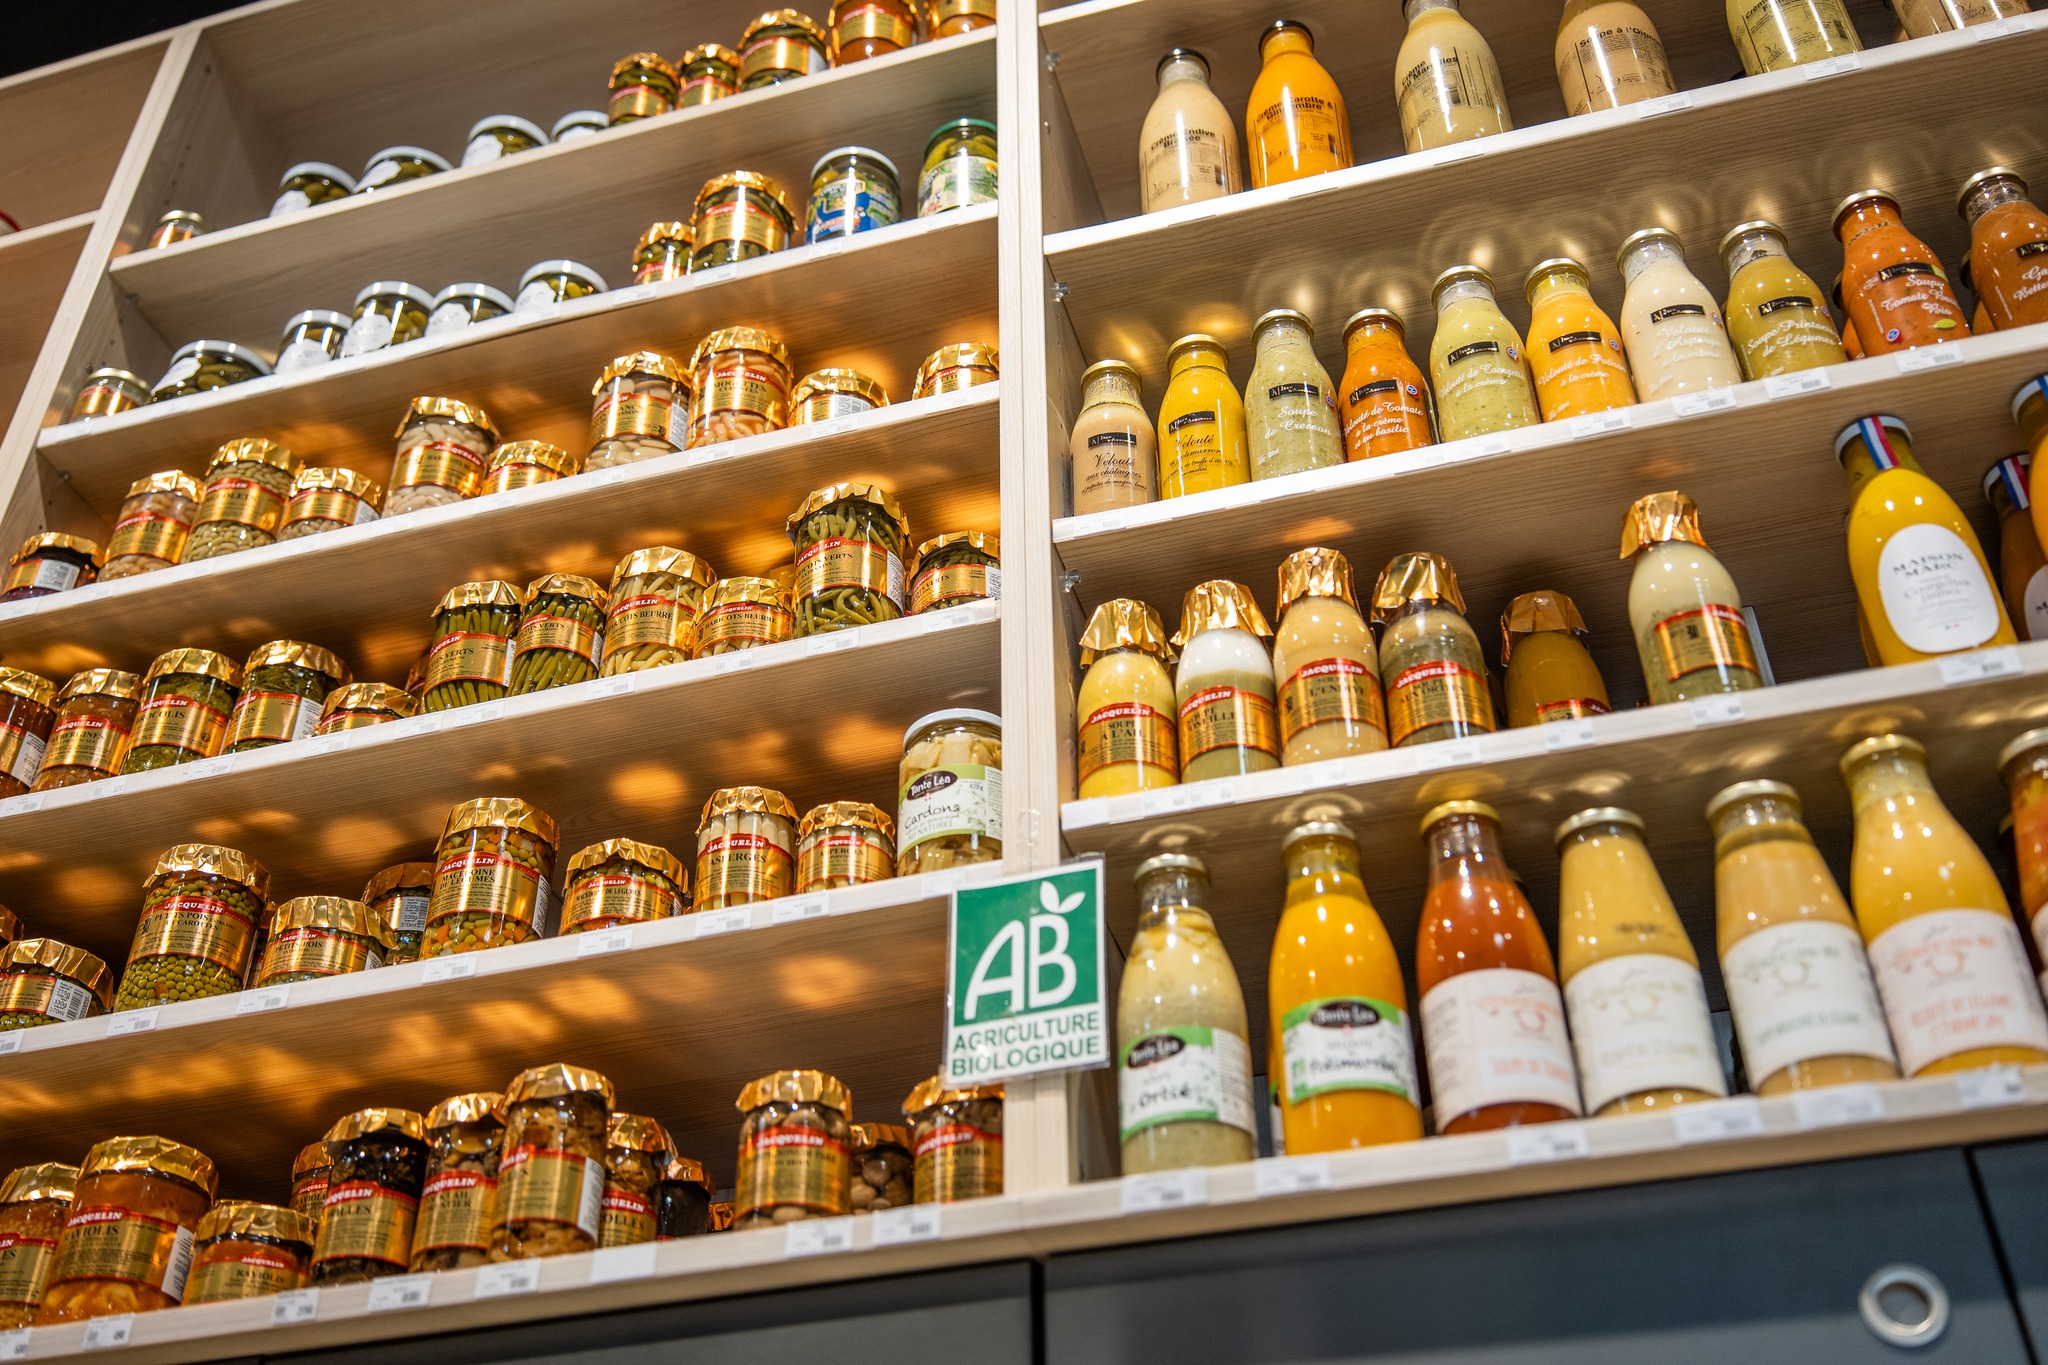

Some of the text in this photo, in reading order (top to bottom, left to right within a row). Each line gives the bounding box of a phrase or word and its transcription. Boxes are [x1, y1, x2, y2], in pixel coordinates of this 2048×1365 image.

[1402, 61, 1426, 86] Crème
[1413, 56, 1458, 81] Marlles
[1257, 96, 1334, 123] Crème arotte &
[1266, 102, 1322, 120] Ginmbre
[1163, 135, 1201, 149] Brasée
[1881, 292, 1929, 311] Tomate
[1747, 326, 1780, 355] Soupe
[1763, 342, 1776, 358] de
[716, 371, 767, 382] JACELIN
[1467, 367, 1480, 379] de
[1539, 360, 1574, 387] Velouté
[1575, 355, 1589, 367] de
[1568, 373, 1580, 383] la
[1580, 370, 1610, 379] crème
[1463, 382, 1475, 393] la
[1475, 377, 1507, 388] crème
[1278, 405, 1319, 419] Soupe
[1371, 404, 1384, 416] de
[1382, 401, 1424, 416] Tomate
[1280, 419, 1332, 436] Cresson
[1362, 422, 1373, 433] la
[1373, 416, 1404, 427] crème
[1174, 433, 1215, 449] Velouté
[1264, 427, 1279, 439] de
[1362, 433, 1374, 443] au
[1375, 423, 1410, 437] basilic
[1093, 452, 1136, 468] Velouté
[1085, 472, 1099, 481] aux
[797, 540, 842, 566] JACQUELIN
[824, 552, 854, 562] VERTS
[1892, 552, 1964, 576] MAISON
[1905, 562, 1957, 580] MARC
[612, 599, 658, 618] JACQUELIN
[639, 609, 673, 620] BEURRE
[717, 606, 753, 615] JACQUELIN
[540, 621, 565, 630] VERTS
[704, 612, 777, 631] HARICOTS BEURRE
[444, 647, 474, 660] VERTS
[1300, 664, 1363, 679] JACQUELIN
[1397, 667, 1458, 689] JACQUELIN
[1310, 683, 1367, 698] L'ENIVE
[1181, 690, 1232, 718] JACQUELIN
[1091, 707, 1151, 724] JACQUELIN
[56, 720, 103, 732] JACQUELIN
[910, 775, 951, 797] Tante Léa
[904, 803, 960, 829] Cardons
[707, 839, 766, 853] JACQUELIN
[821, 837, 862, 847] JACQUELIN
[442, 857, 495, 872] JACQULIN
[164, 902, 224, 914] JACQUELIN
[155, 912, 185, 922] PETTS
[186, 912, 209, 921] POIS
[963, 913, 1078, 1021] AB
[952, 1011, 1099, 1054] AGRICULTURE
[951, 1035, 1099, 1077] BIOLOGIQUE
[422, 1177, 477, 1198] JACQUELIN
[601, 1197, 645, 1213] QUELIN
[68, 1211, 123, 1227] JACQUELIN
[601, 1213, 646, 1230] OLLES
[240, 1256, 285, 1269] JACQUELIN
[237, 1269, 285, 1284] RAVIOLIS
